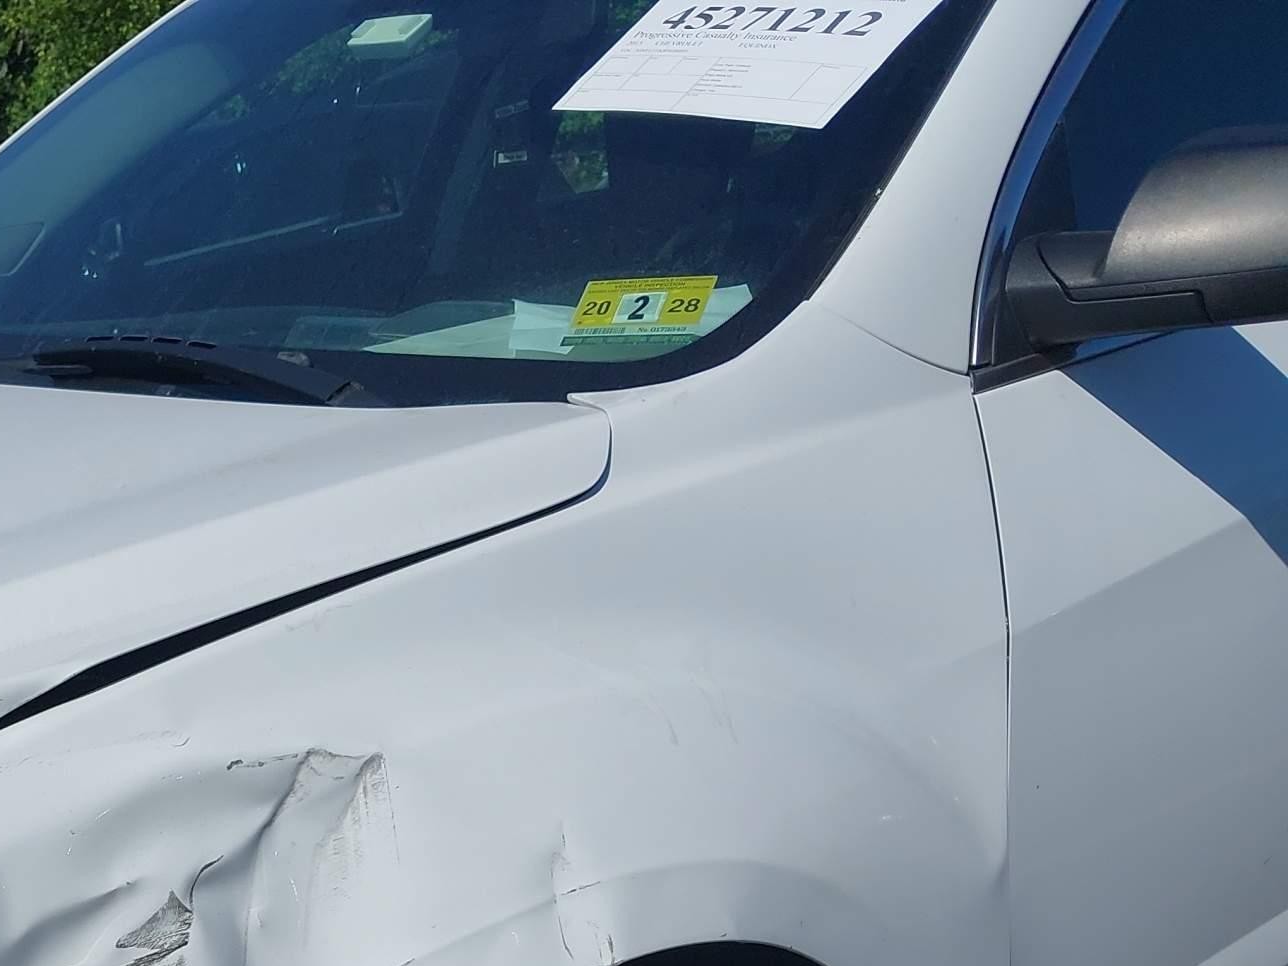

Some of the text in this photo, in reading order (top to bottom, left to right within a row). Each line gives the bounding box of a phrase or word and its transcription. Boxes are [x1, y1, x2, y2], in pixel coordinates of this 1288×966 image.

[663, 5, 884, 38] 45271212
[633, 31, 798, 42] Progressive Casualty Insurance
[582, 295, 701, 320] 20 2 28
